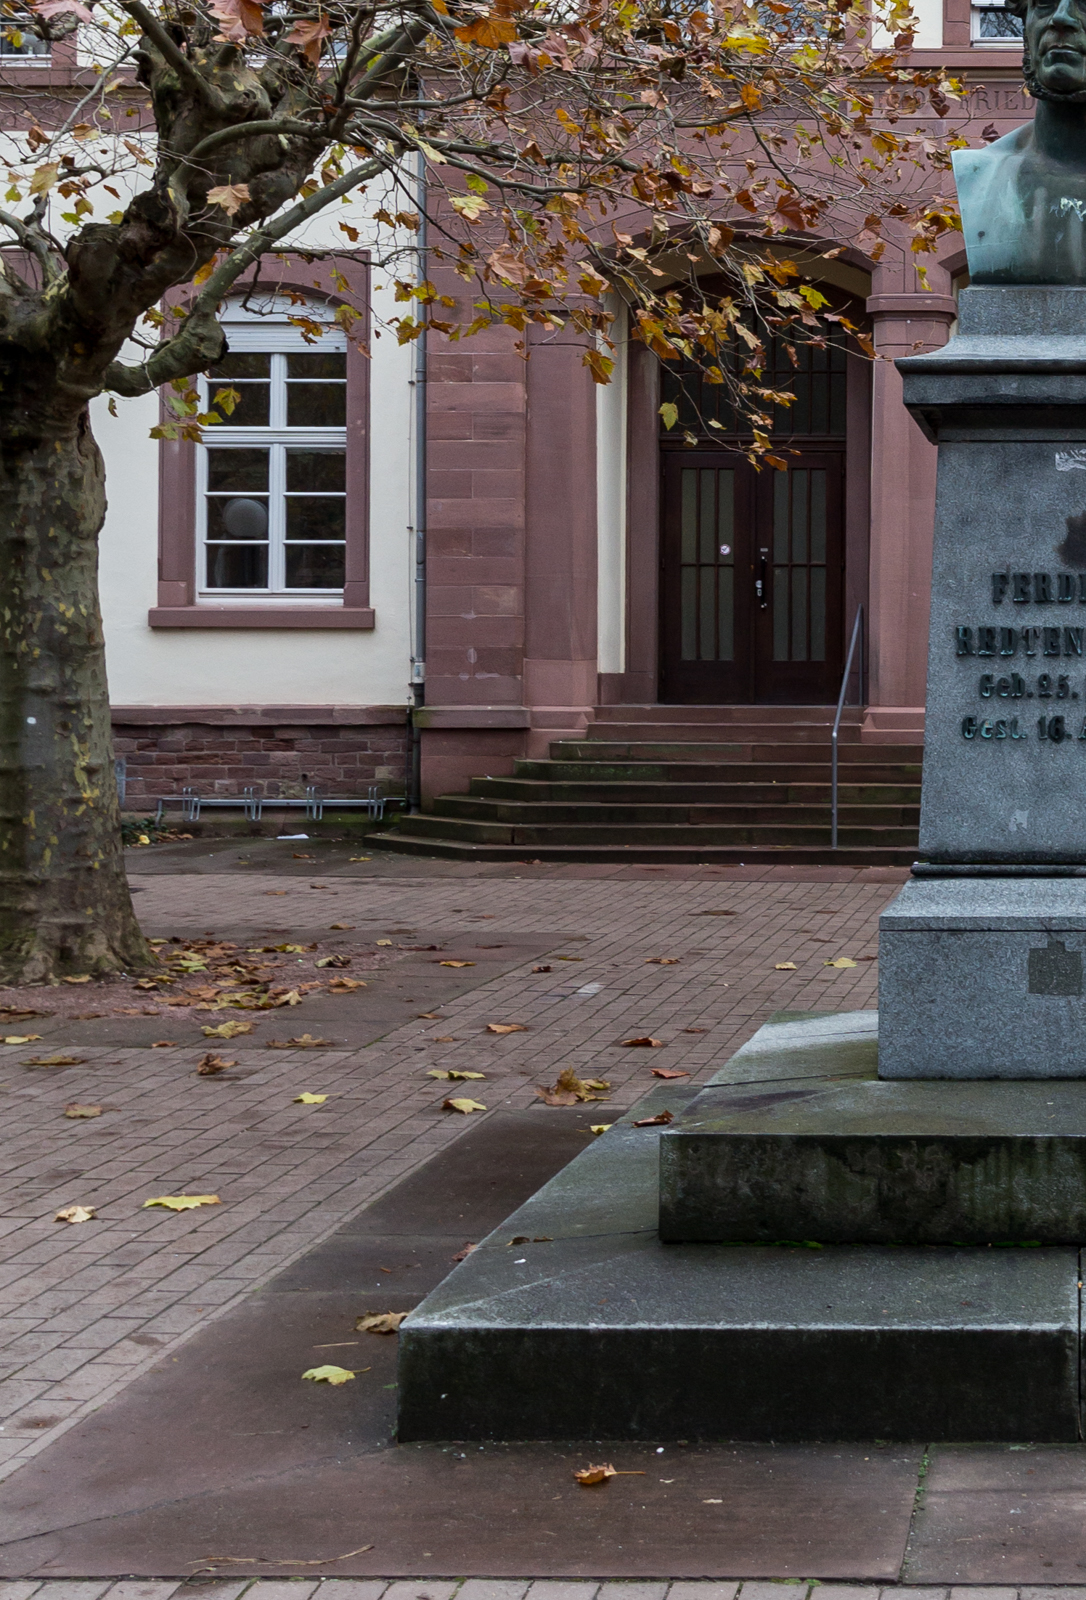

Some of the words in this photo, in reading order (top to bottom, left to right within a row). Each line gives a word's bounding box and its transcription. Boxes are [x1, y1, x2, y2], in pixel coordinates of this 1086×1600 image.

[979, 672, 1034, 699] Geb.
[1038, 674, 1079, 699] 25.
[962, 715, 1027, 740] Gest.
[1037, 714, 1072, 743] 16.
